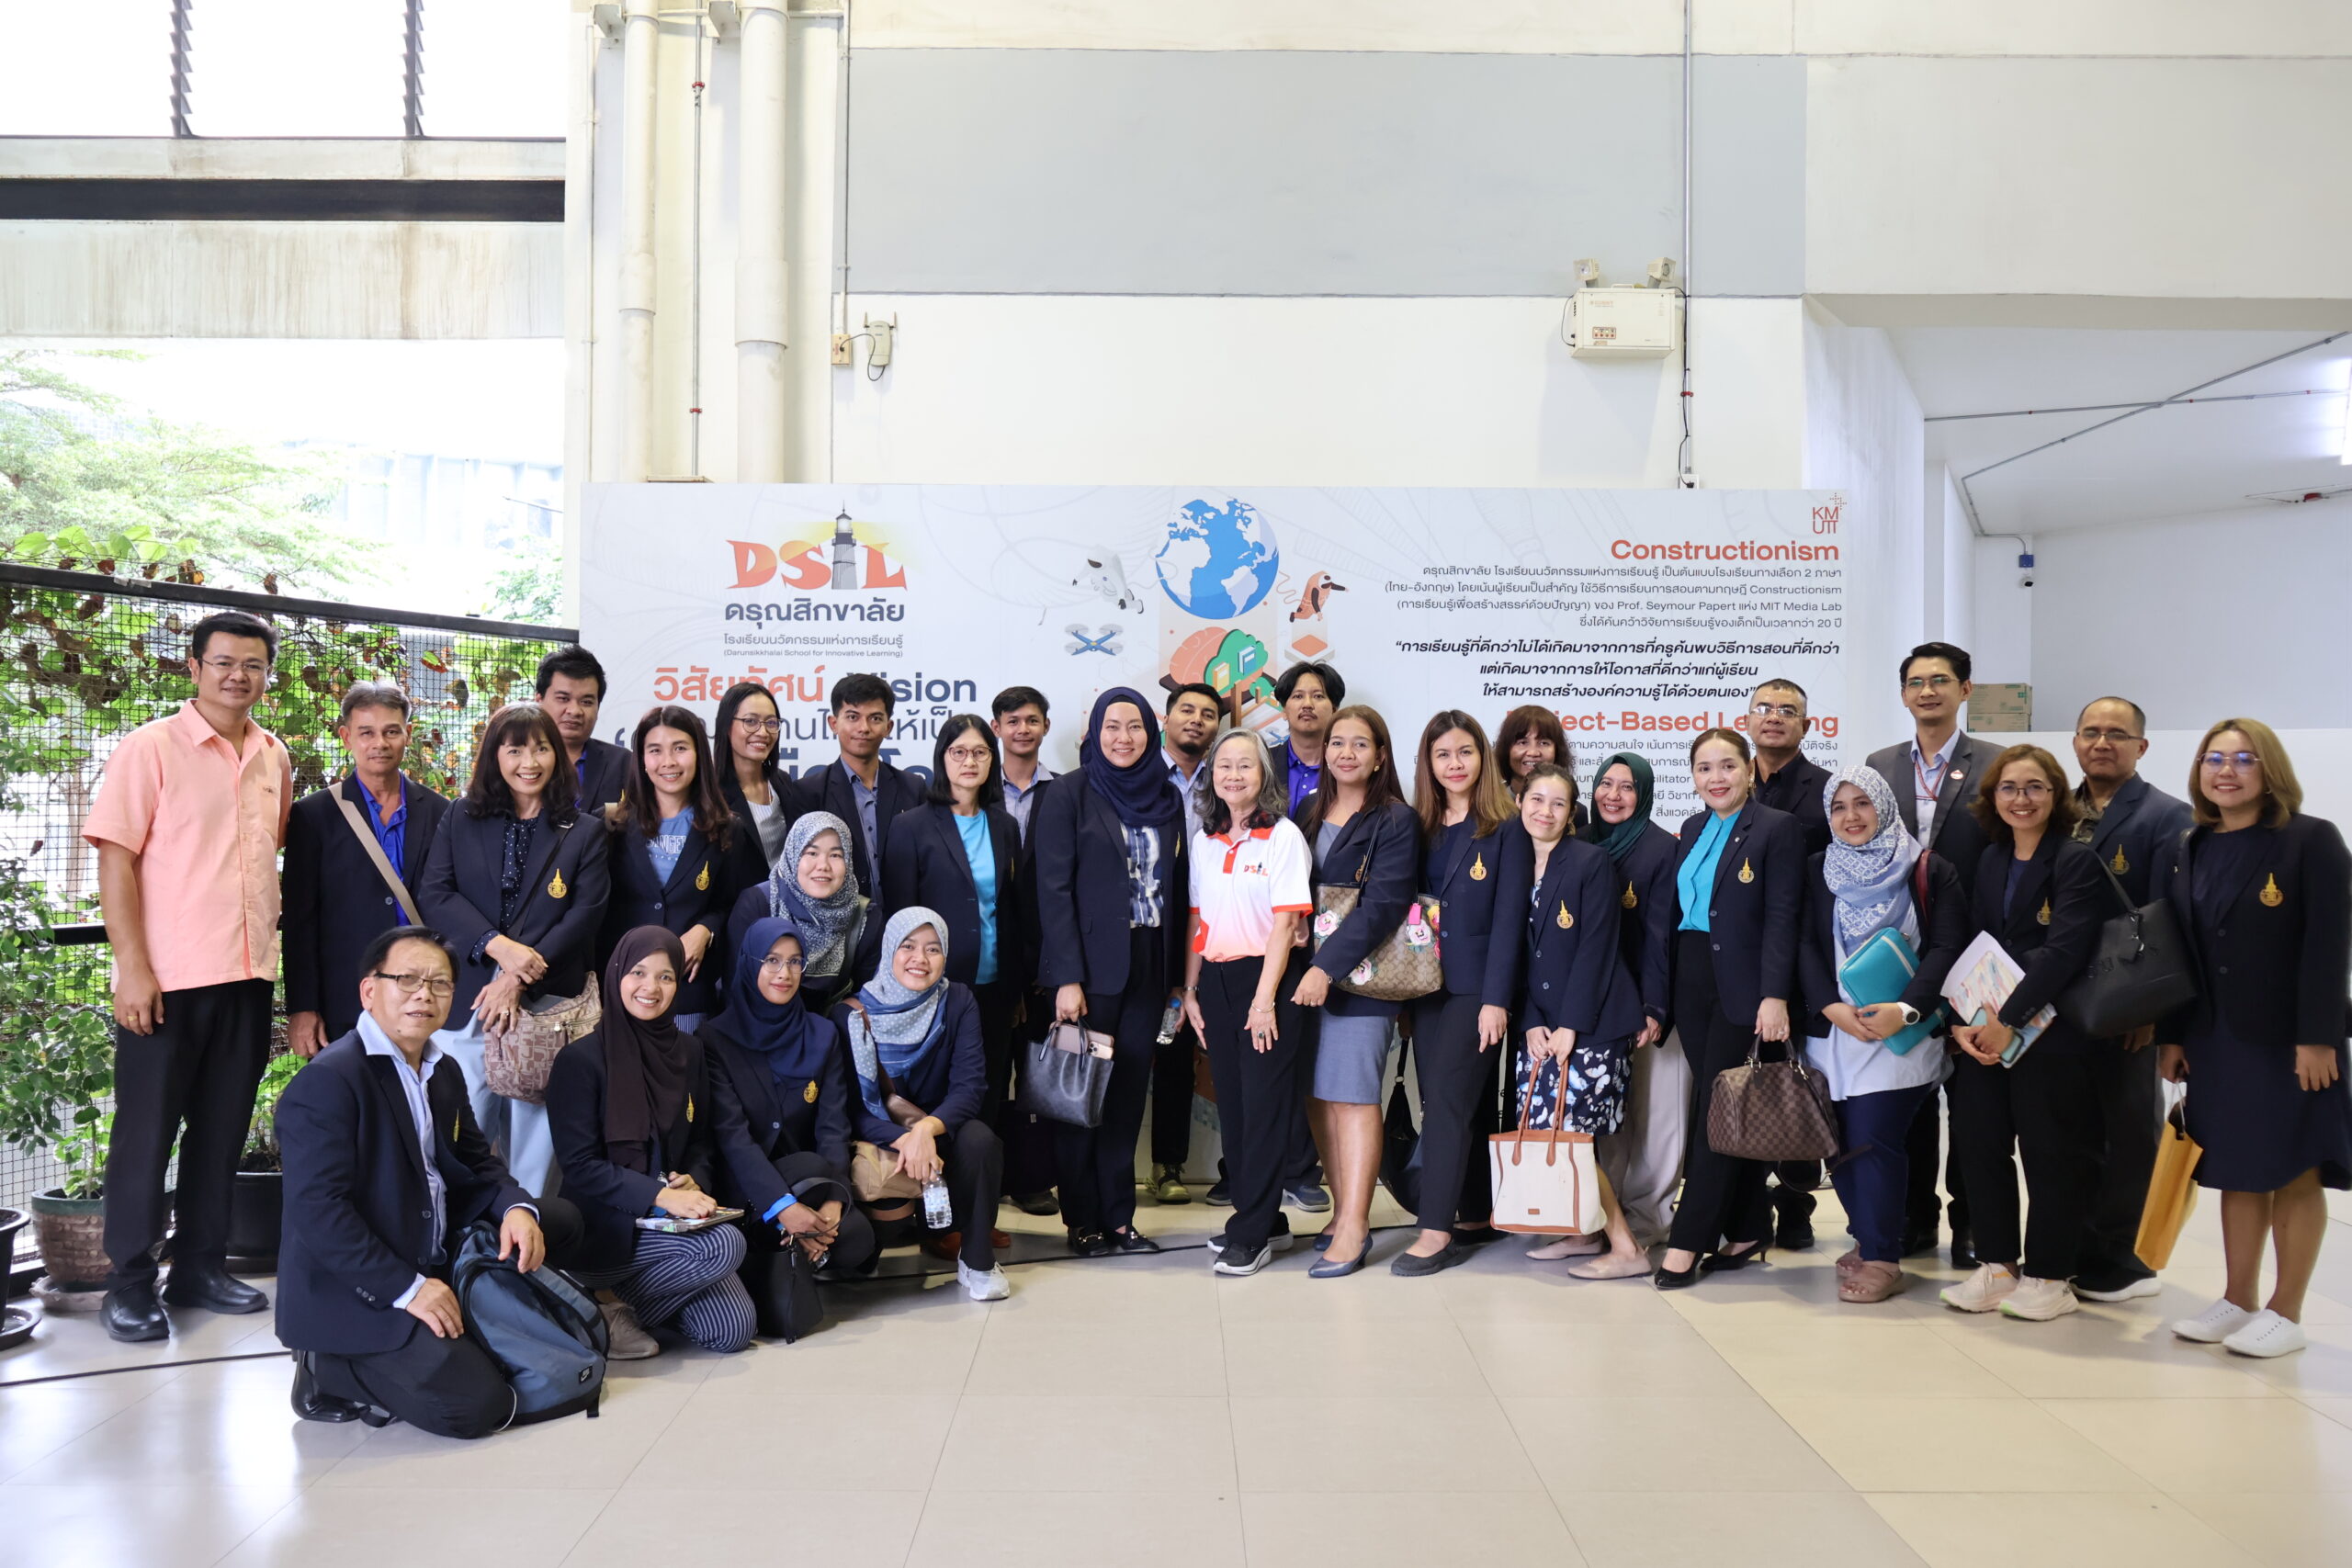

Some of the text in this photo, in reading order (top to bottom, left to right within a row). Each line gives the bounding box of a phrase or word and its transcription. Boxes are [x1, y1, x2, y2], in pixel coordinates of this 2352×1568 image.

[1611, 539, 1839, 561] Constructionism
[1422, 564, 1842, 580] ดรุณสิกขาลัย โรงเรียนนวัตกรรมแห่งการเรียนรู้ เป็นต้นแบบโรงเรียนทางเลือก 2 ภาษา
[1457, 580, 1578, 596] โดยเน้นผู้เรียนเป็นสำคัญ
[1749, 584, 1842, 595] Constructionism
[724, 596, 905, 630] ดรุณสิกขาลัย
[1396, 596, 1842, 613] (การเรียนรู้เพื่อสร้างสรรค์ด้วยปัญญา) ของ Prof. Seymour Papert แห่ง MIT Media Lab
[1816, 618, 1832, 629] 20
[1834, 616, 1842, 629] ปี
[723, 632, 904, 649] โรงเรียนนวัตกรรมแห่งการเรียนรู้
[723, 649, 904, 659] (Darunsikkhalai School for Innovative Learning)
[1479, 659, 1759, 681] แต่เกิดมาจากการให้โอกาสที่ดีกว่าแก่ผู้เรียน
